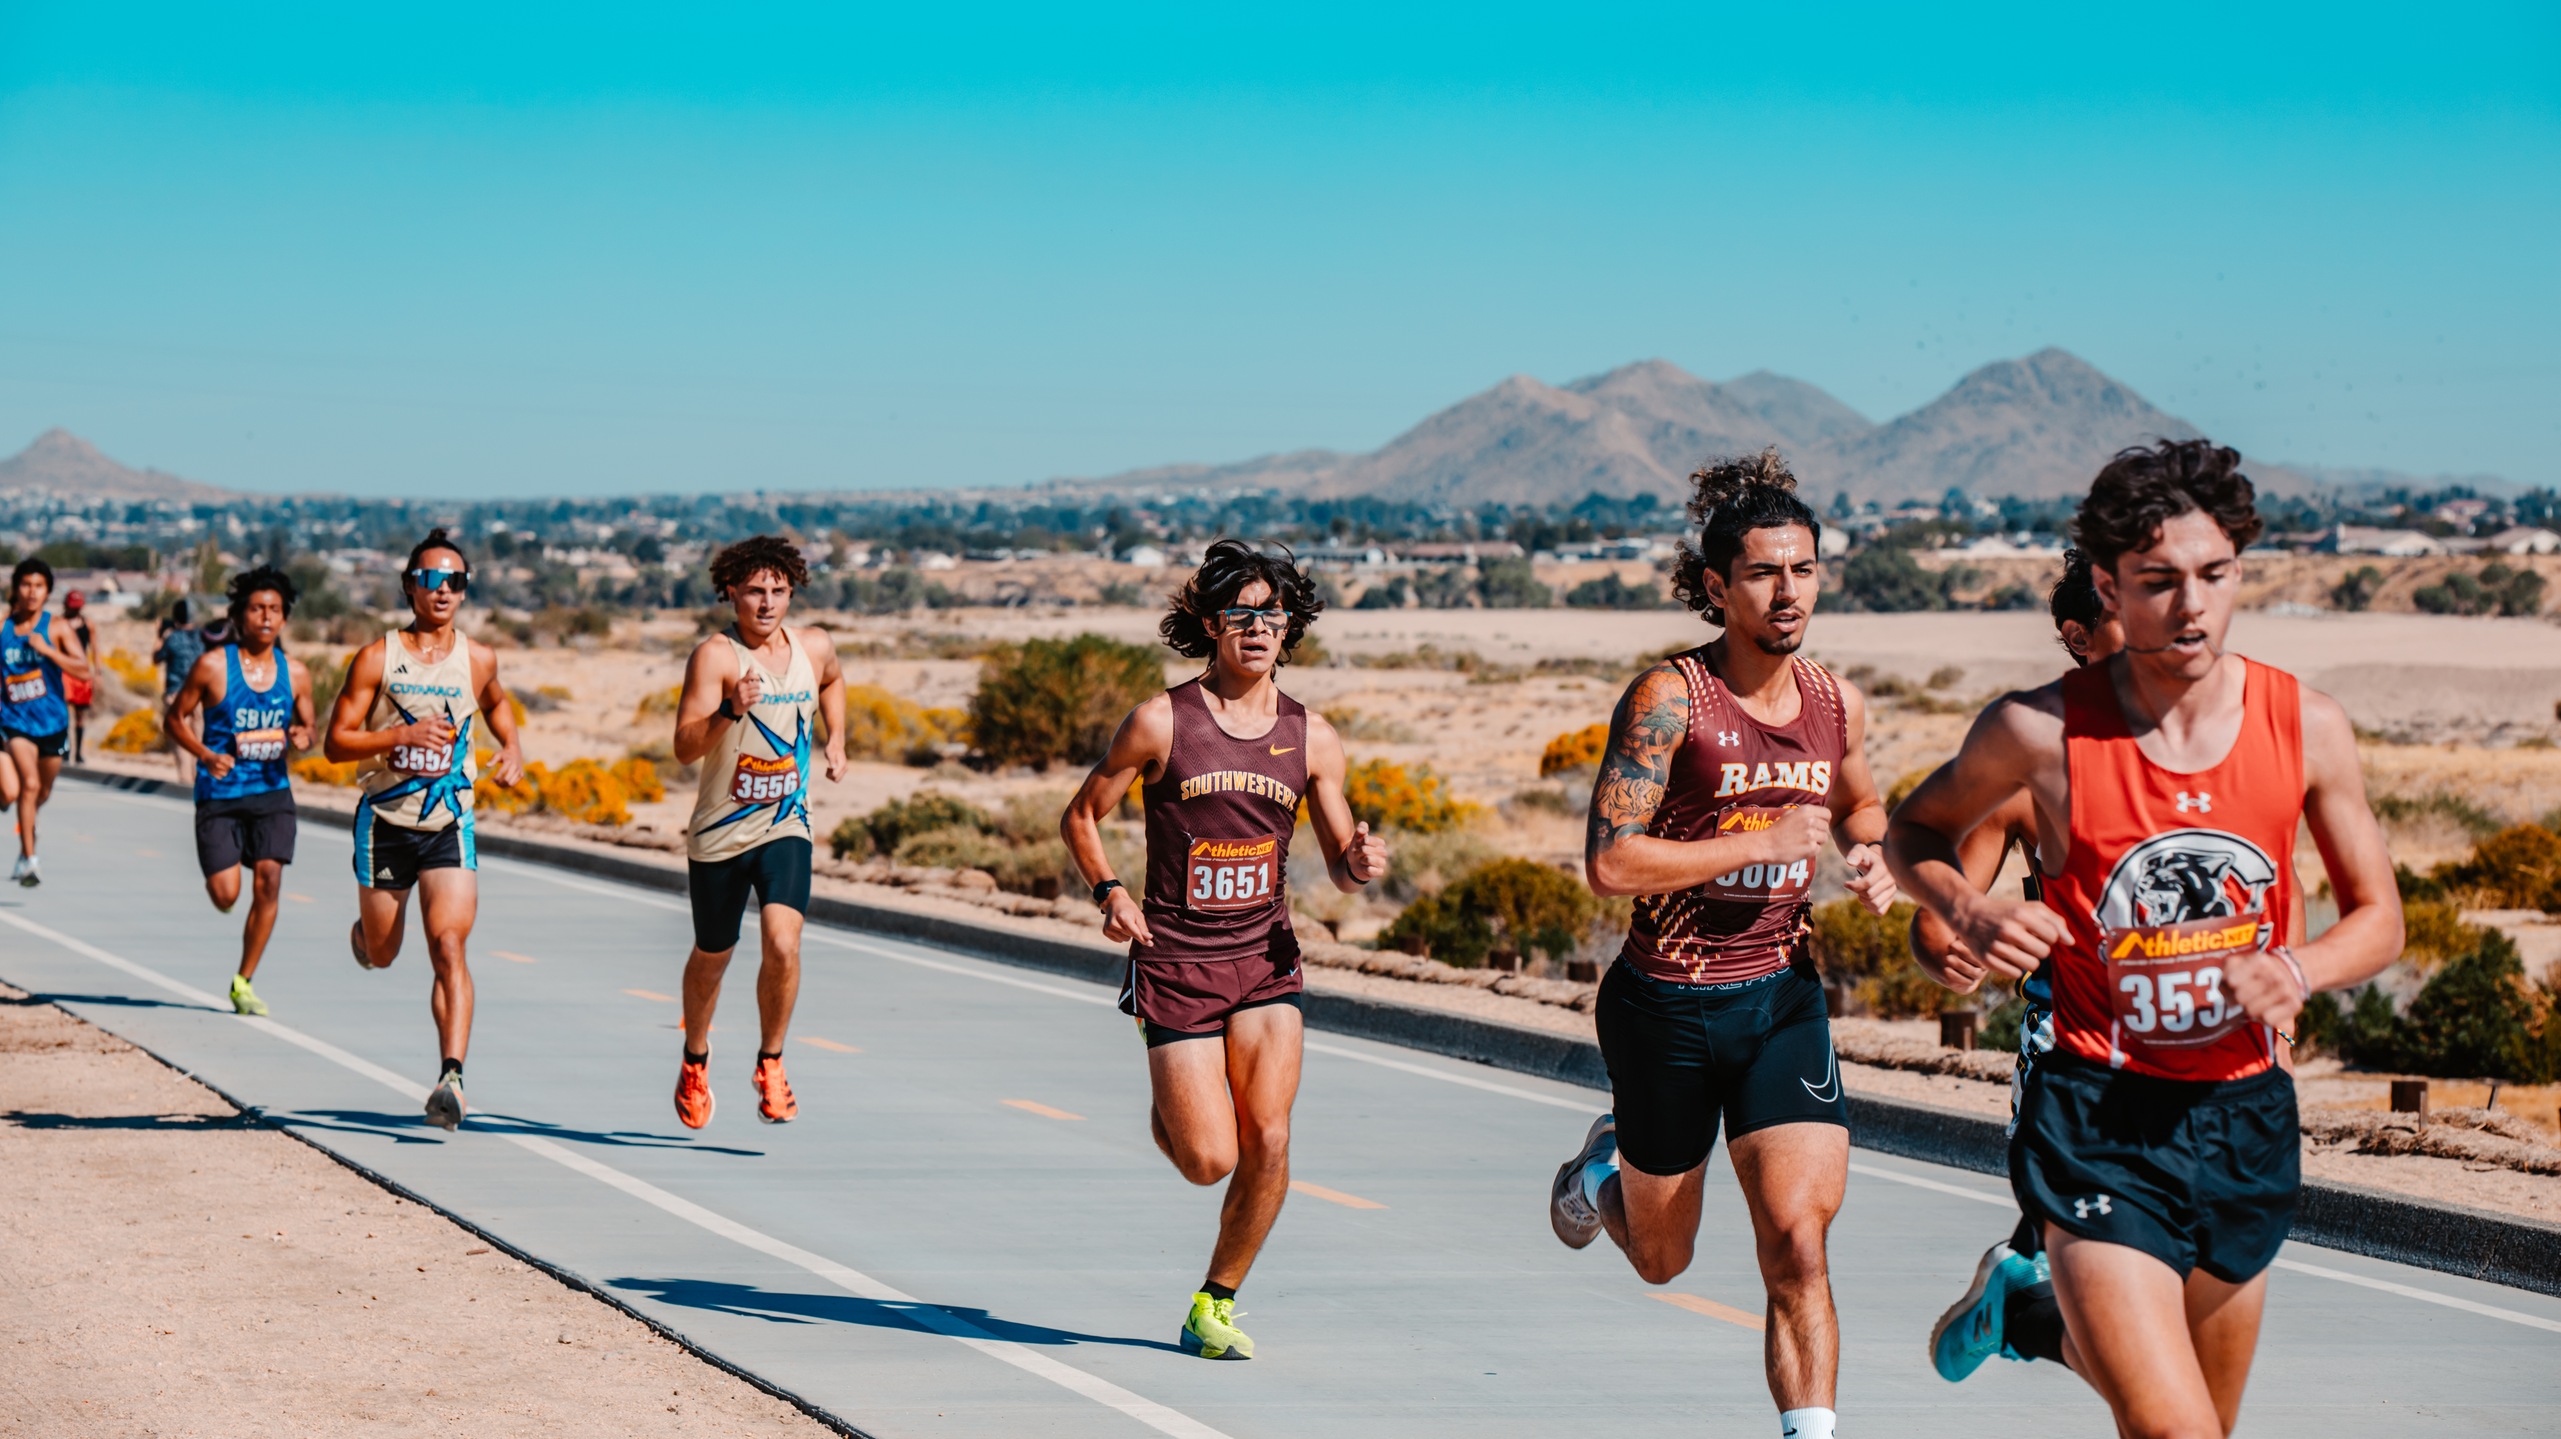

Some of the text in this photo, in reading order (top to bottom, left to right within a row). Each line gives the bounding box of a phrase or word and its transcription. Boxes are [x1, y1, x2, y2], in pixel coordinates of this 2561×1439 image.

[389, 682, 463, 698] CUYAMACA
[235, 707, 285, 729] SBVC
[394, 745, 453, 772] 3552
[736, 771, 798, 799] 3556
[1714, 760, 1832, 798] RAMS
[1193, 862, 1270, 901] 3651
[2119, 966, 2244, 1033] 353
